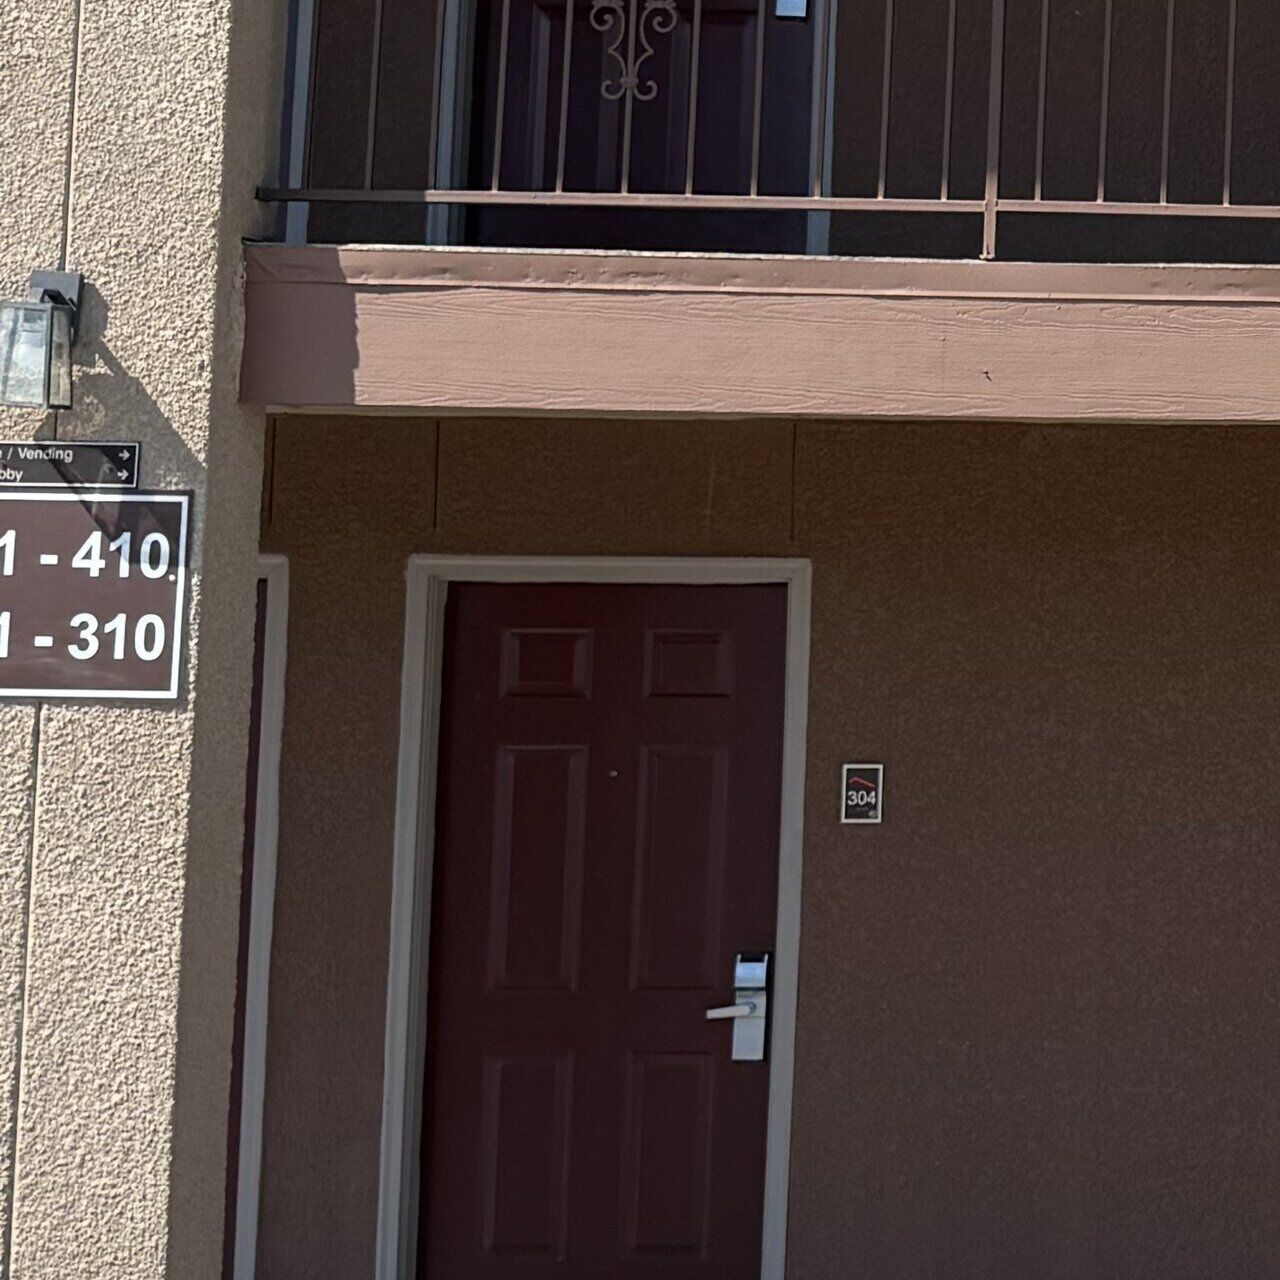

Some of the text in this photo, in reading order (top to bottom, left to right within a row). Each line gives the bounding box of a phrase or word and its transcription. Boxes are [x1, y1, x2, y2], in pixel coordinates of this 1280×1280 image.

[18, 447, 73, 463] Vending
[71, 531, 170, 579] 410
[67, 613, 165, 661] 310
[847, 790, 875, 805] 304
